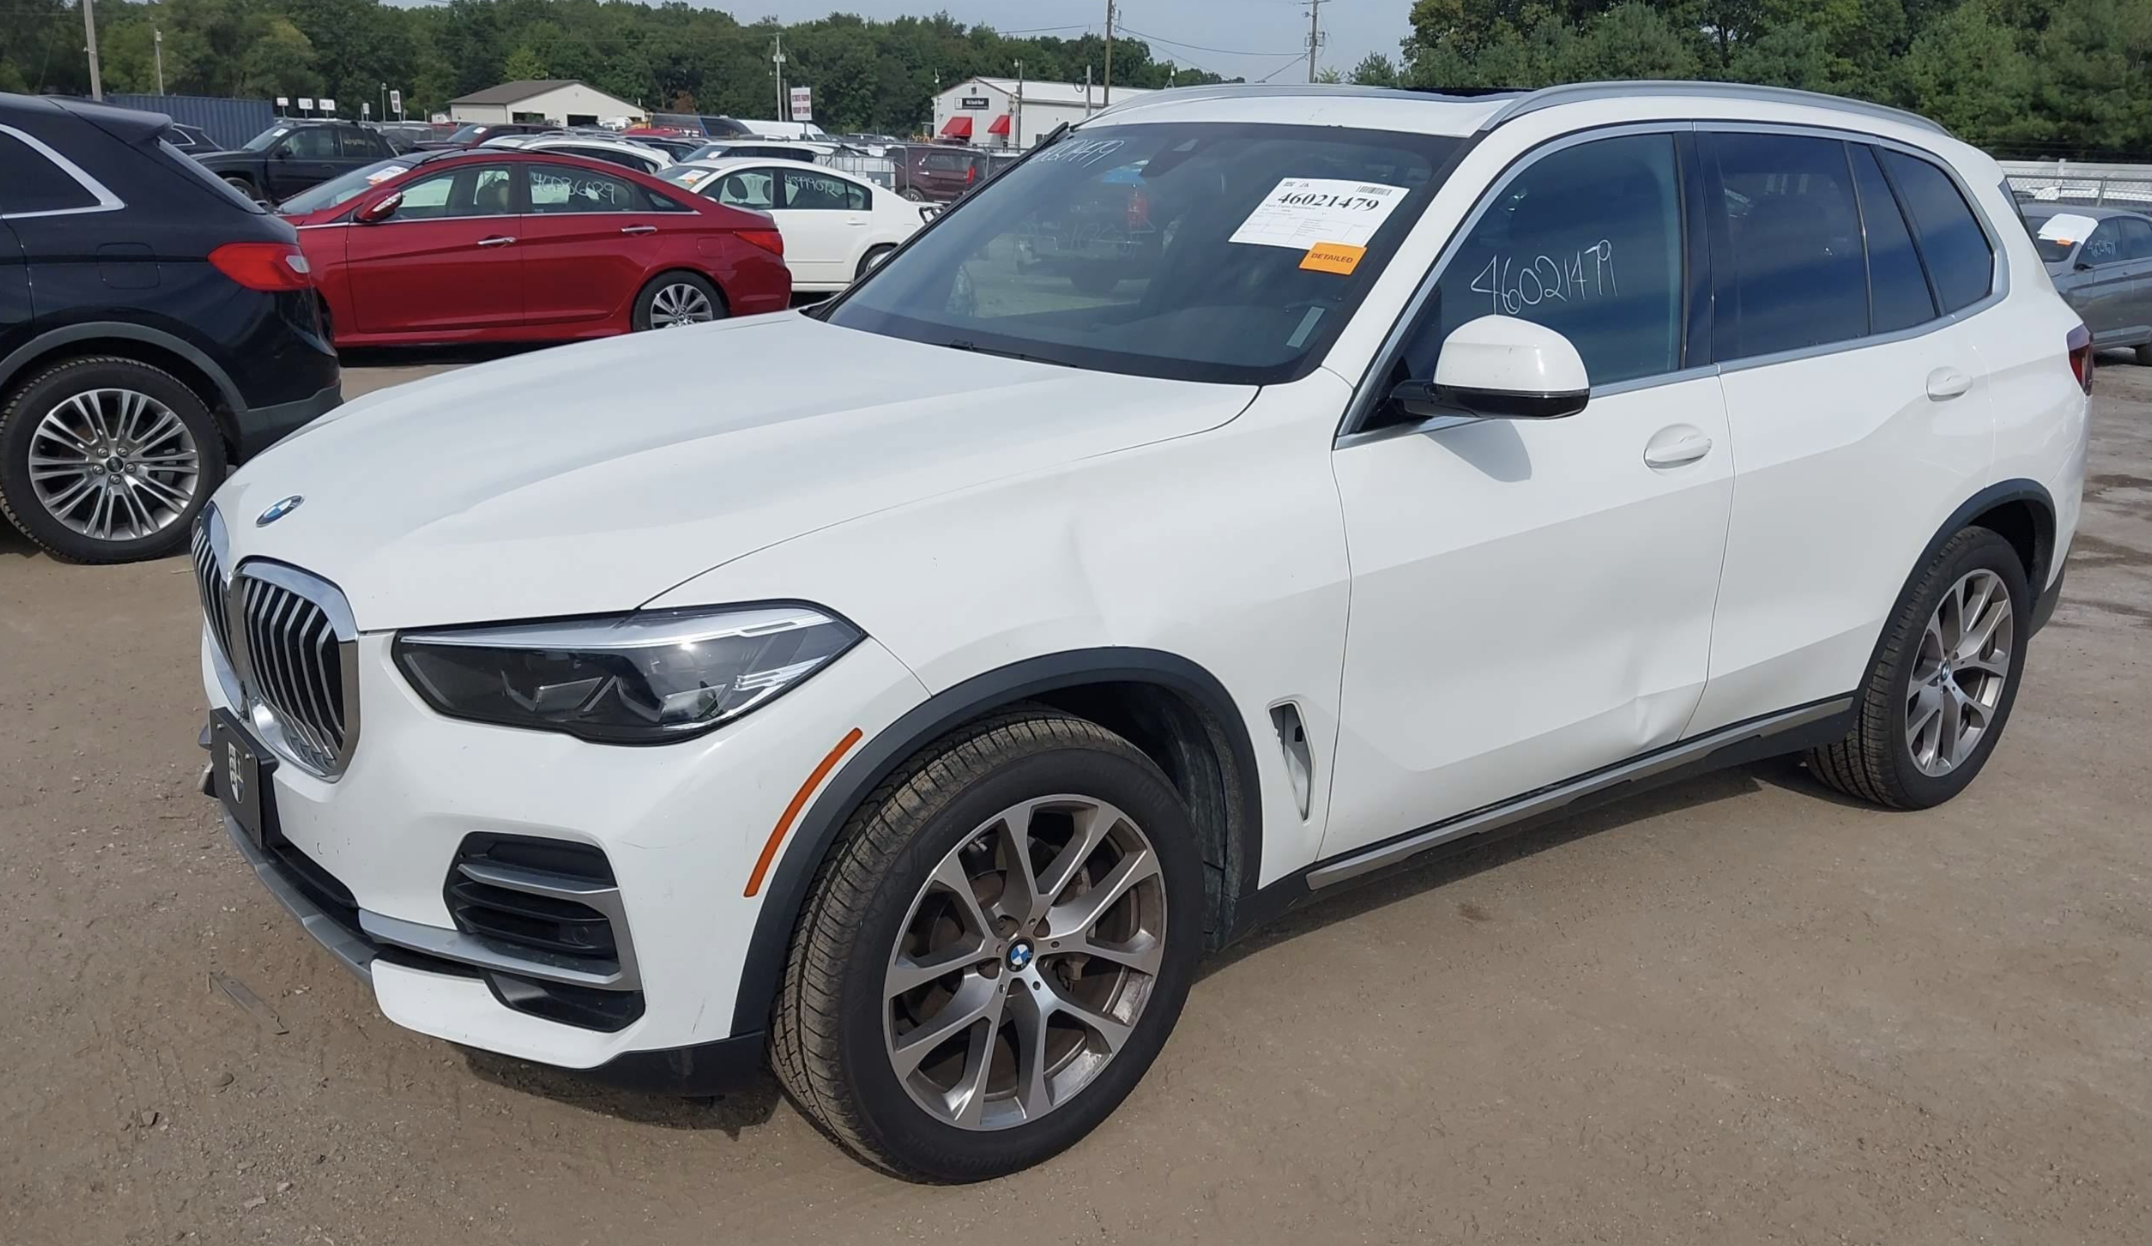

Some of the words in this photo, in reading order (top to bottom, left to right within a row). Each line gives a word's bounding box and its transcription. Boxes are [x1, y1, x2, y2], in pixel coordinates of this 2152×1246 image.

[1277, 191, 1379, 212] 46021479
[1310, 252, 1354, 264] DETAILED
[1470, 239, 1618, 315] 46021479
